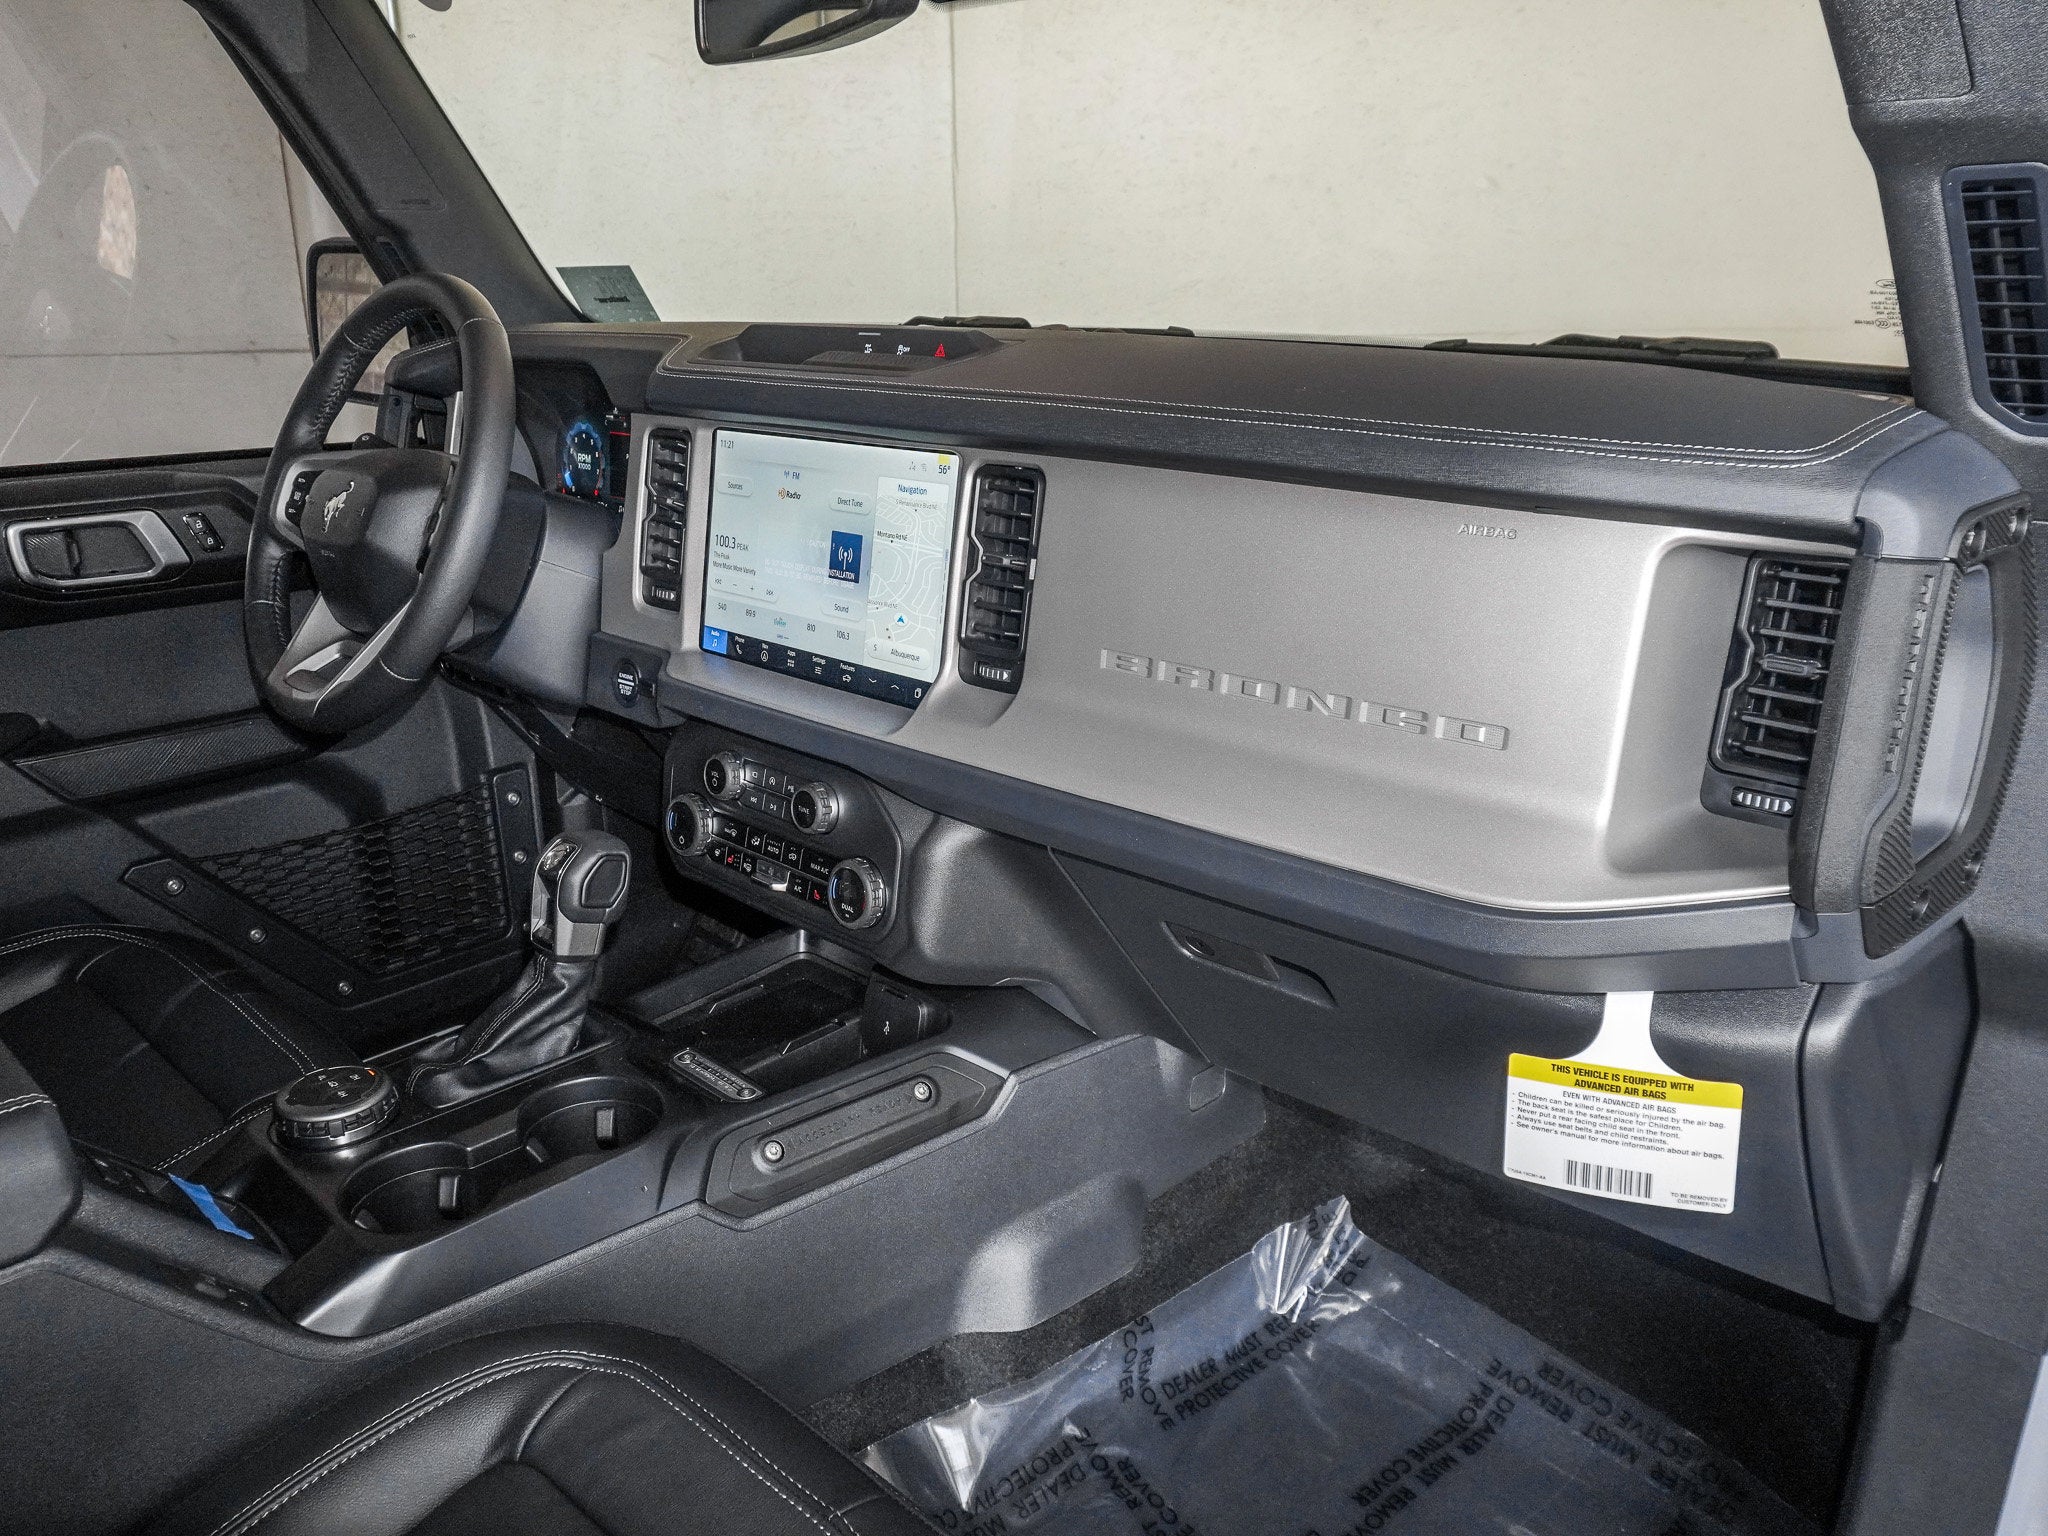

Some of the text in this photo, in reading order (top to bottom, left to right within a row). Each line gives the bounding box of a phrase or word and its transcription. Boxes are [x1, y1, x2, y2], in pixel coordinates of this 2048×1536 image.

[720, 439, 734, 450] 11:21
[577, 453, 592, 464] RPM
[792, 471, 800, 480] FM
[938, 464, 951, 475] 56°
[727, 481, 744, 491] Sources
[897, 484, 928, 496] Navigation
[786, 489, 801, 500] Radio
[837, 497, 864, 509] Direct Tune
[1457, 523, 1518, 540] AIRBAG
[715, 534, 750, 551] 100.3 PEAK
[718, 602, 727, 612] 540
[834, 603, 849, 614] Sound
[710, 629, 720, 637] Audio
[806, 622, 816, 633] 810
[734, 635, 745, 644] Phone
[836, 630, 850, 641] 106.3
[812, 655, 826, 665] Settings
[890, 648, 920, 662] Albuquerque
[840, 662, 856, 673] Features
[618, 672, 634, 681] ENGINE
[620, 688, 632, 696] STOP
[1100, 648, 1510, 751] BRONCO
[711, 771, 720, 779] VOL
[767, 845, 780, 855] AUTO
[810, 861, 822, 873] MAX
[841, 902, 854, 914] DUAL
[1551, 1063, 1695, 1092] THIS VEHICLE IS EQUIPPED WITH
[1574, 1078, 1667, 1100] ADVANCED AIR BAGS
[1562, 1090, 1677, 1114] EVEN WITH ADVANCED AIR BAGS
[1518, 1091, 1548, 1102] Children
[1549, 1098, 1562, 1106] can
[1564, 1099, 1573, 1107] be
[1575, 1101, 1595, 1111] killed
[1606, 1107, 1640, 1120] seriously
[1642, 1112, 1669, 1122] injured
[1671, 1116, 1681, 1125] by
[1682, 1117, 1696, 1125] the
[1709, 1120, 1726, 1130] bag.
[1518, 1098, 1531, 1107] The
[1532, 1101, 1549, 1111] back
[1551, 1105, 1566, 1114] seat
[1576, 1109, 1588, 1117] the
[1589, 1112, 1612, 1121] safest
[1613, 1116, 1634, 1126] place
[1635, 1118, 1646, 1127] for
[1648, 1121, 1683, 1132] Children.
[1517, 1105, 1538, 1115] Never
[1539, 1110, 1552, 1119] put
[1559, 1115, 1573, 1123] rear
[1575, 1117, 1597, 1128] facing
[1598, 1121, 1618, 1130] child
[1619, 1125, 1636, 1133] seat
[1637, 1126, 1644, 1134] in
[1646, 1128, 1658, 1136] the
[1660, 1130, 1681, 1140] front.
[1517, 1113, 1542, 1125] Always
[1558, 1121, 1574, 1131] seat
[1575, 1124, 1593, 1133] belts
[1594, 1128, 1609, 1136] and
[1610, 1130, 1629, 1140] child
[1630, 1134, 1670, 1146] restraints.
[1516, 1120, 1530, 1130] See
[1531, 1124, 1559, 1135] owner's
[1560, 1130, 1587, 1140] manual
[1588, 1134, 1599, 1143] for
[1600, 1138, 1620, 1146] more
[1621, 1140, 1666, 1153] information
[1667, 1146, 1690, 1156] about
[1703, 1151, 1725, 1160] bags.
[1119, 1329, 1138, 1402] COVER
[1161, 1357, 1220, 1400] DEALER
[1224, 1332, 1263, 1365] MUST
[1174, 1320, 1321, 1421] PROTECTIVE COVER
[1138, 1346, 1176, 1431] REMOVE
[1485, 1357, 1575, 1423] REMOVE
[1537, 1361, 1613, 1417] COVER
[1352, 1458, 1412, 1507] COVER
[1012, 1462, 1087, 1521] DEALER
[1118, 1457, 1179, 1525] COVER
[1342, 1486, 1418, 1536] REMOV
